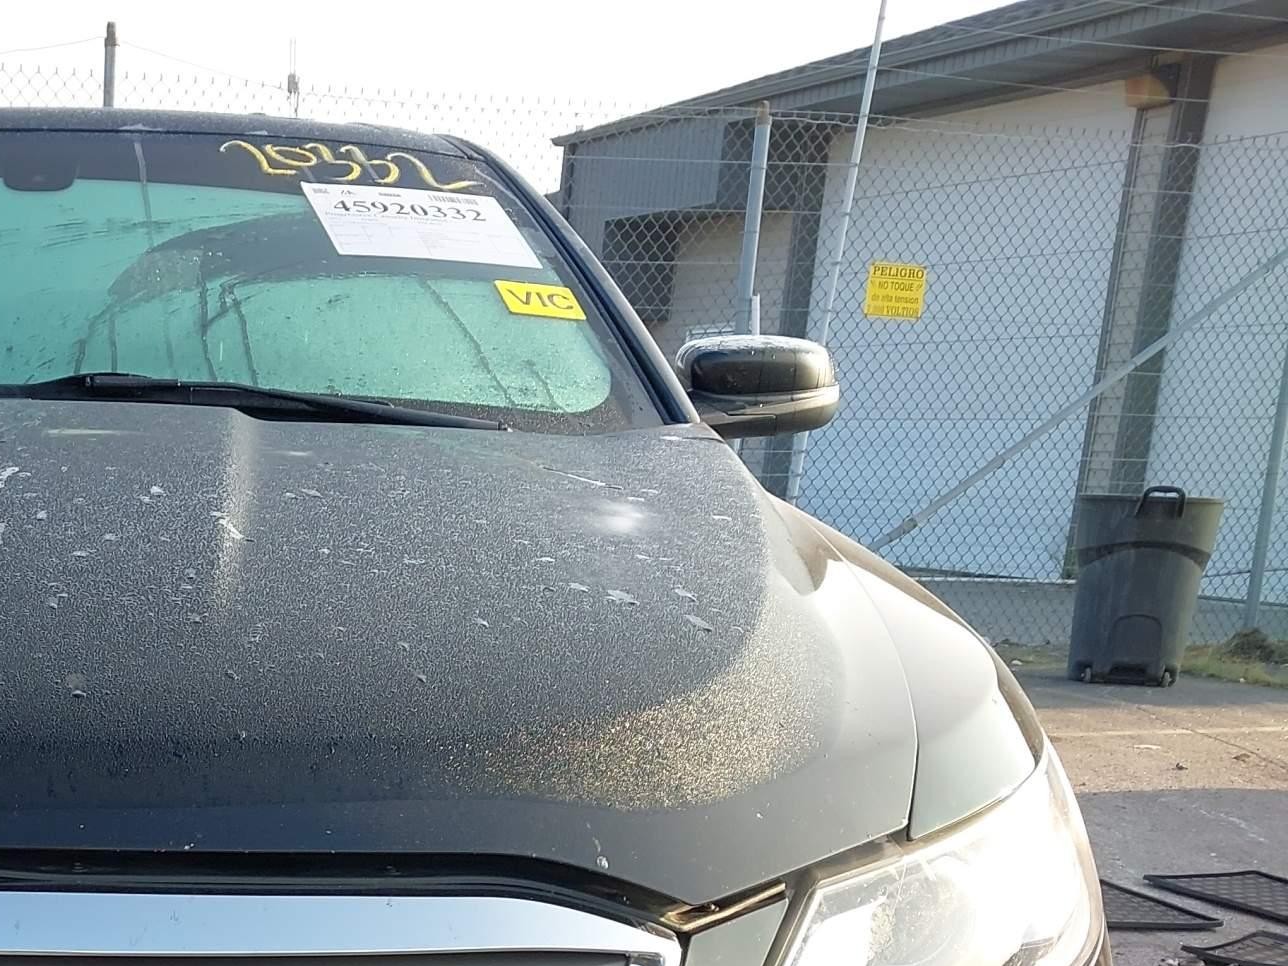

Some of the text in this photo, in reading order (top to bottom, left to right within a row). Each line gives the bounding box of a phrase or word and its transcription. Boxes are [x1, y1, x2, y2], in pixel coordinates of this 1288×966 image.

[333, 200, 487, 221] 45920332
[873, 266, 924, 279] PELIGRO
[878, 280, 889, 290] NO
[890, 281, 914, 292] TOQUE
[506, 288, 574, 310] VIC
